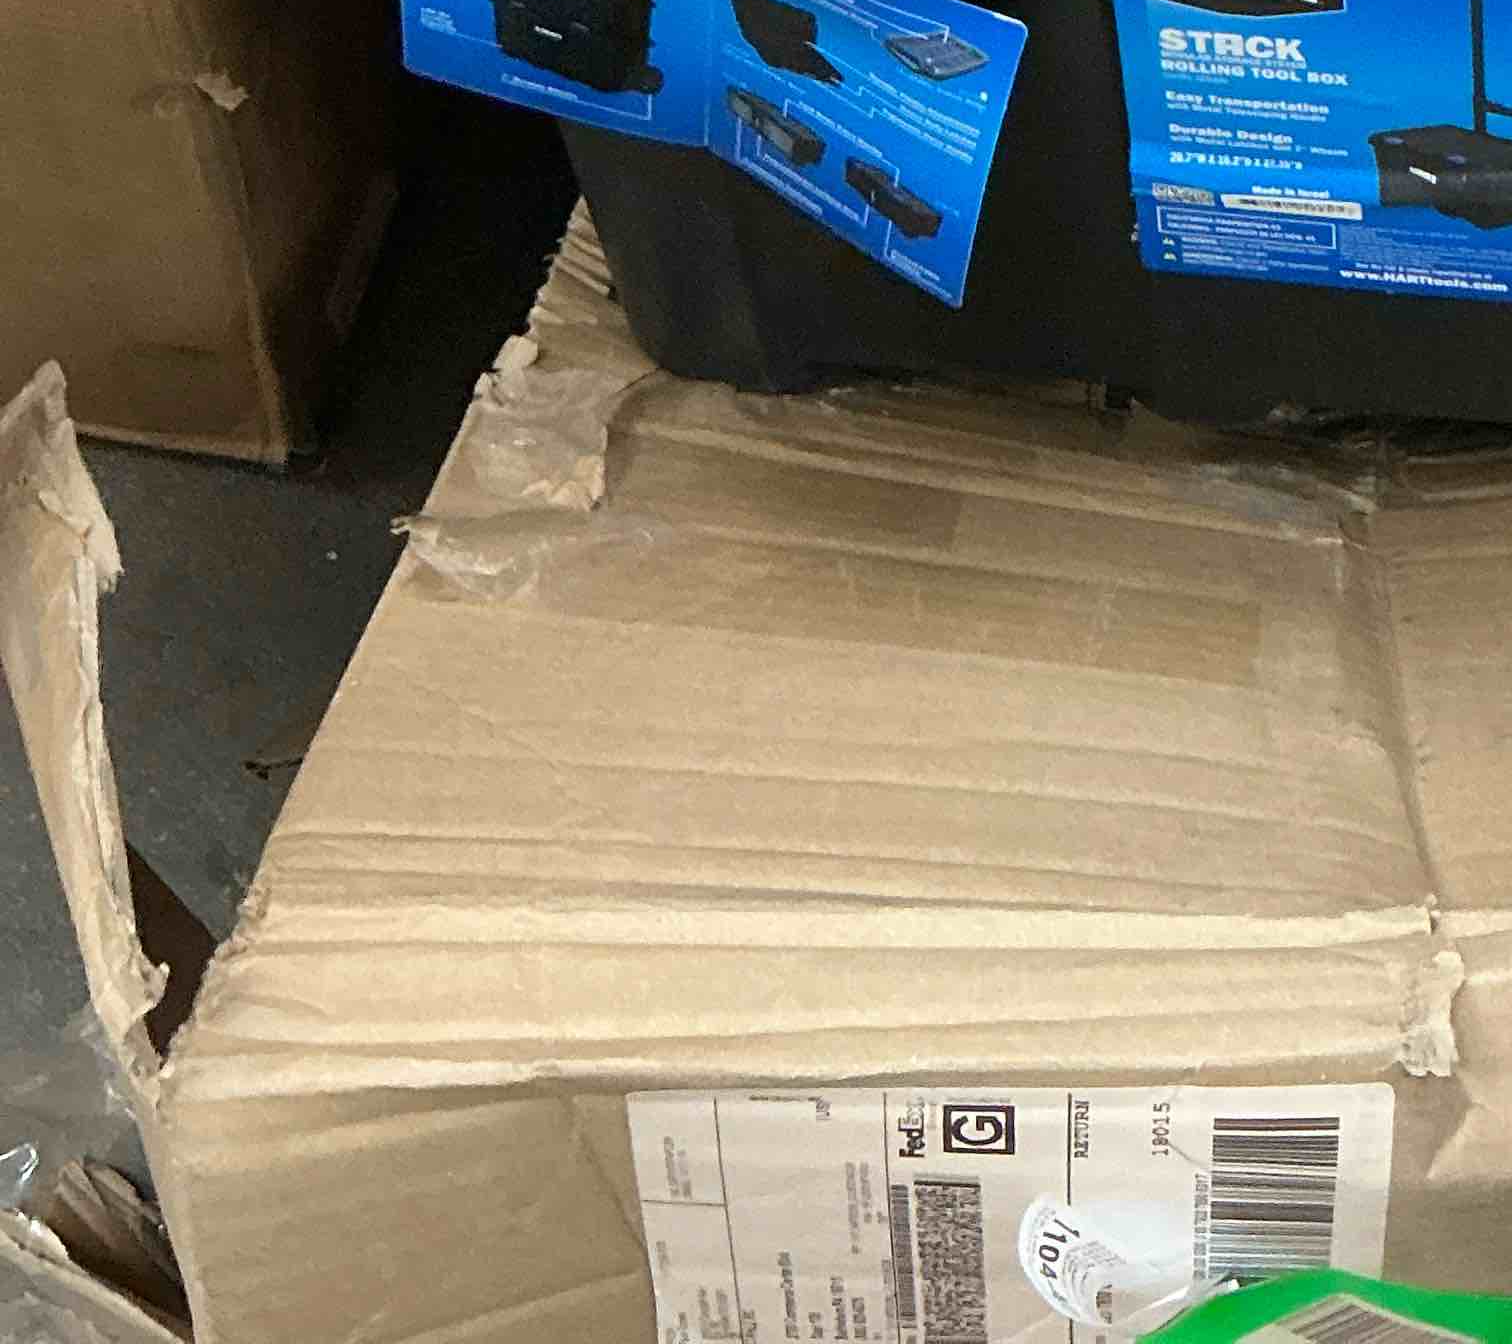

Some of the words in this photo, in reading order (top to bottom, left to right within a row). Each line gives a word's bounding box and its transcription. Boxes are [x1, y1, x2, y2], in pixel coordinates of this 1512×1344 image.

[1159, 28, 1304, 62] STACK
[1160, 59, 1245, 78] ROLLING
[1250, 67, 1302, 82] TOOL
[1307, 72, 1349, 86] BOX
[1165, 90, 1204, 108] Easy
[1209, 95, 1329, 115] Transportation
[1168, 123, 1232, 139] Durable
[1236, 130, 1293, 145] Design
[1339, 269, 1508, 293] www.HARTtools.com
[897, 1096, 925, 1158] FedEx
[951, 1114, 1003, 1146] G
[1074, 1100, 1089, 1159] RETURN
[1152, 1102, 1171, 1156] 18015
